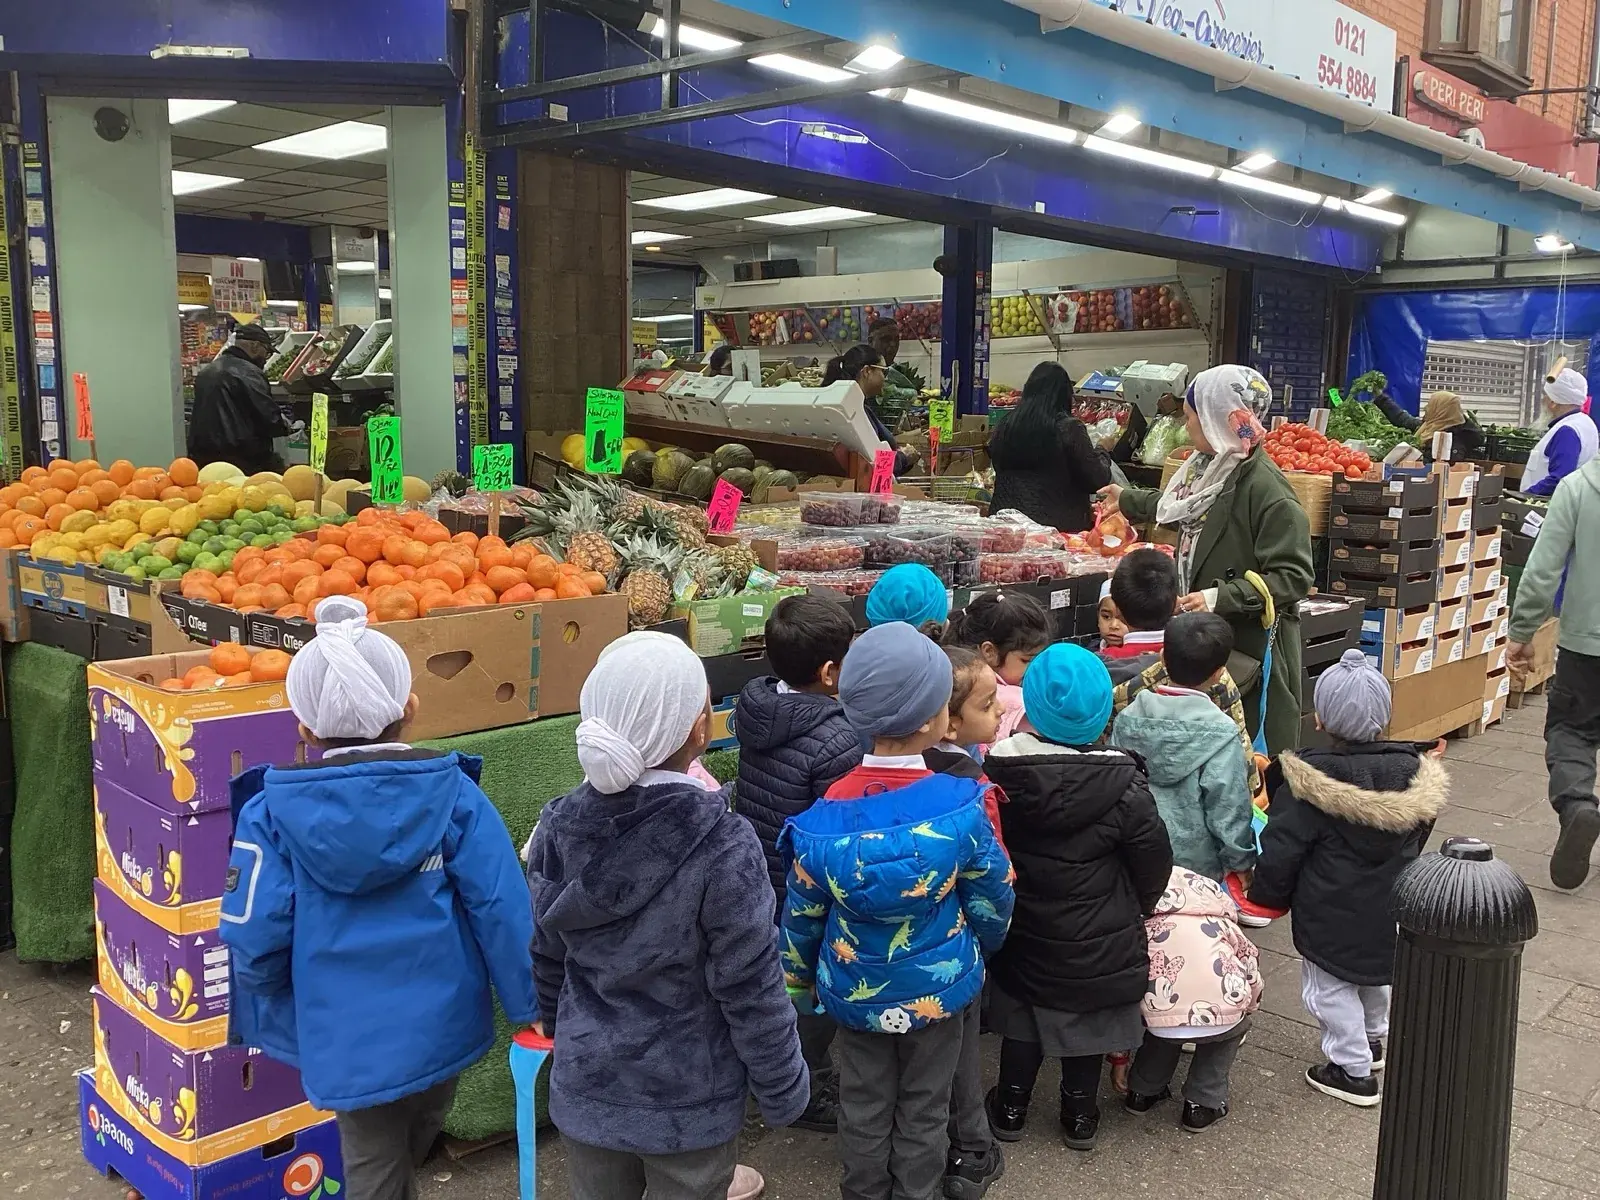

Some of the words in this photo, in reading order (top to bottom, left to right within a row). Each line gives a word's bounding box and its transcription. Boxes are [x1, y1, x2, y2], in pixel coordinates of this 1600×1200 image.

[1335, 17, 1365, 56] 0121
[1318, 54, 1343, 90] 554
[1346, 66, 1377, 103] 8884
[1430, 77, 1456, 107] PERI
[1460, 91, 1485, 120] PERI
[475, 200, 484, 238] CAUTION
[1, 296, 13, 332] CAUTION
[477, 302, 485, 339] CAUTION
[4, 346, 16, 382] CAUTION
[477, 352, 486, 389] CAUTION
[7, 396, 19, 432] CAUTION
[126, 1074, 149, 1108] Miska
